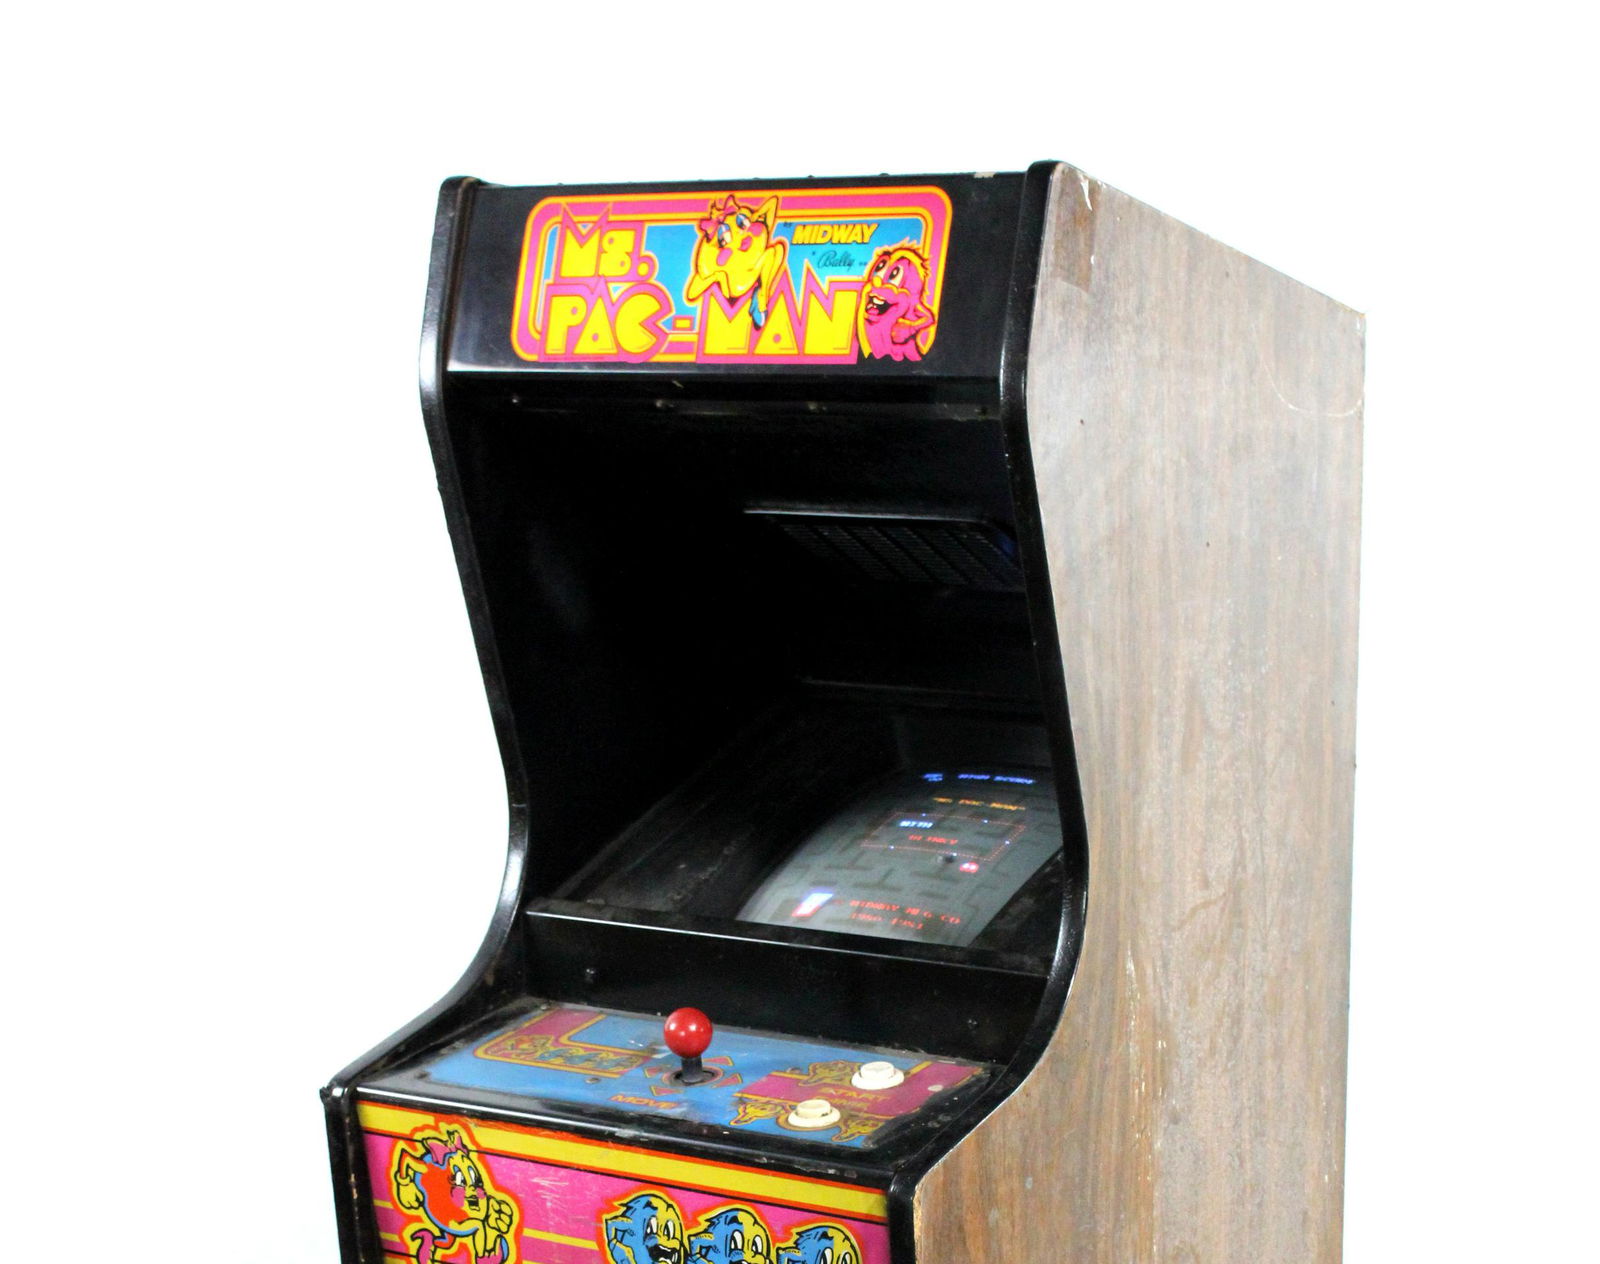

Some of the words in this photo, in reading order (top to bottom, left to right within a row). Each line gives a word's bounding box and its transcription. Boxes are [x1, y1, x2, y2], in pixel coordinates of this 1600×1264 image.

[791, 223, 879, 245] MIDWAY
[817, 250, 855, 272] Bally
[544, 289, 859, 357] PAC-MAN
